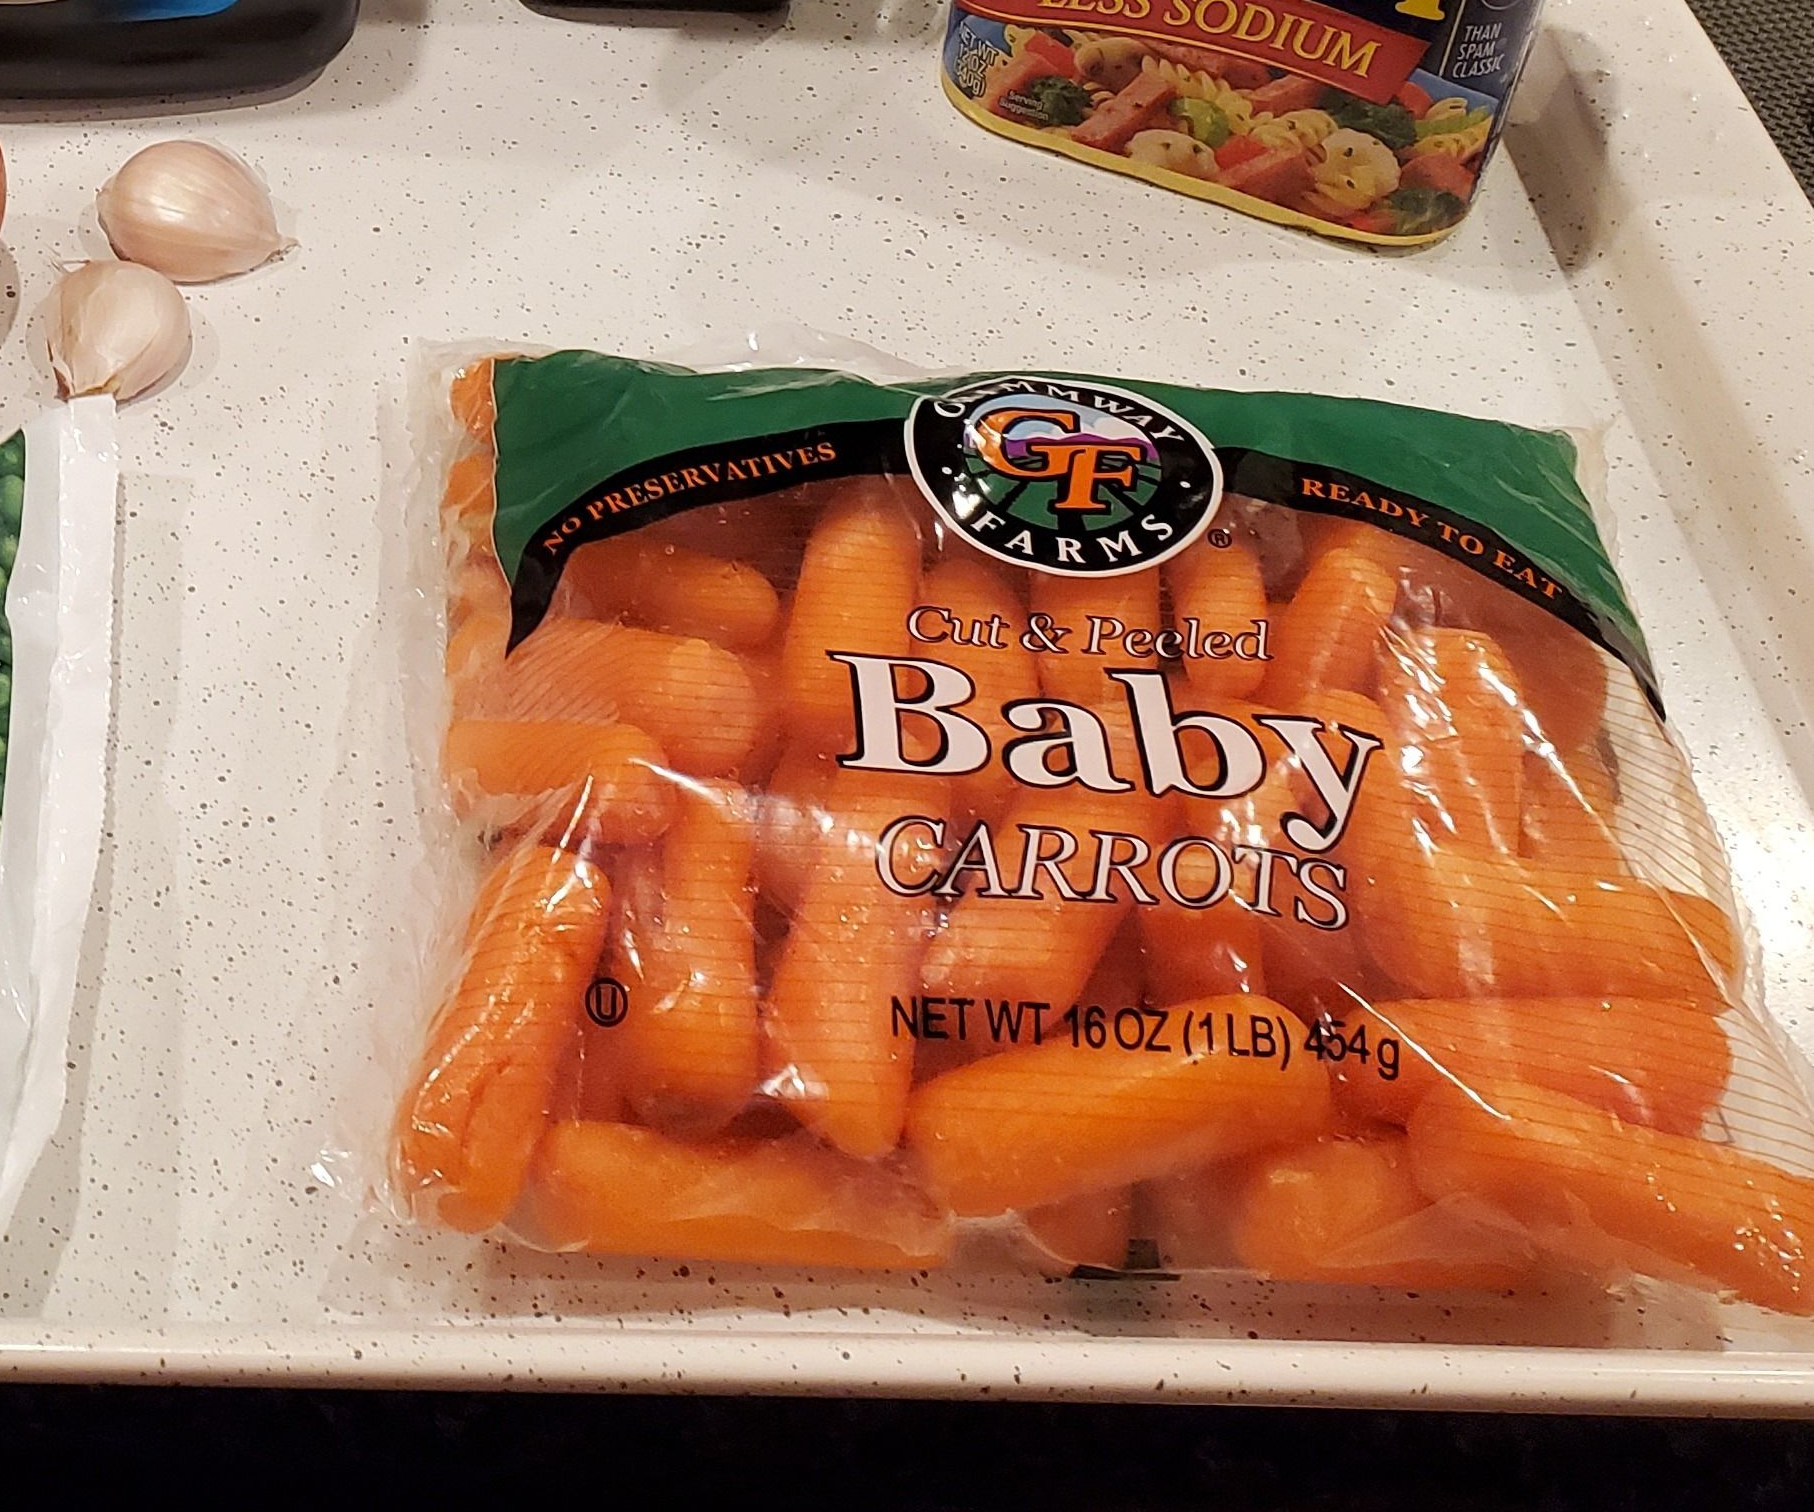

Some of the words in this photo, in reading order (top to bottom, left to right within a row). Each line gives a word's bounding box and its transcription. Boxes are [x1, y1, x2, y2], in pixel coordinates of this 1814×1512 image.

[1457, 41, 1496, 61] SPAM
[1464, 22, 1502, 43] THAN
[1452, 53, 1505, 79] CLASSIC
[542, 516, 583, 555] NO
[586, 442, 837, 521] PRESERVATIVES
[970, 511, 1174, 564] FARMS
[1302, 478, 1430, 528] READY
[1437, 521, 1485, 555] TO
[1493, 549, 1563, 600] EAT
[907, 605, 1010, 649] Cut
[1019, 611, 1072, 654] &
[1086, 615, 1274, 661] Peeled
[828, 651, 1384, 854] Baby
[874, 815, 1349, 932] CARROTS
[890, 995, 975, 1041] NET
[986, 999, 1051, 1046] WT
[1067, 1004, 1108, 1050] 16
[1113, 1007, 1173, 1054] OZ
[1182, 1009, 1216, 1059] (1
[1226, 1013, 1292, 1072] LB)
